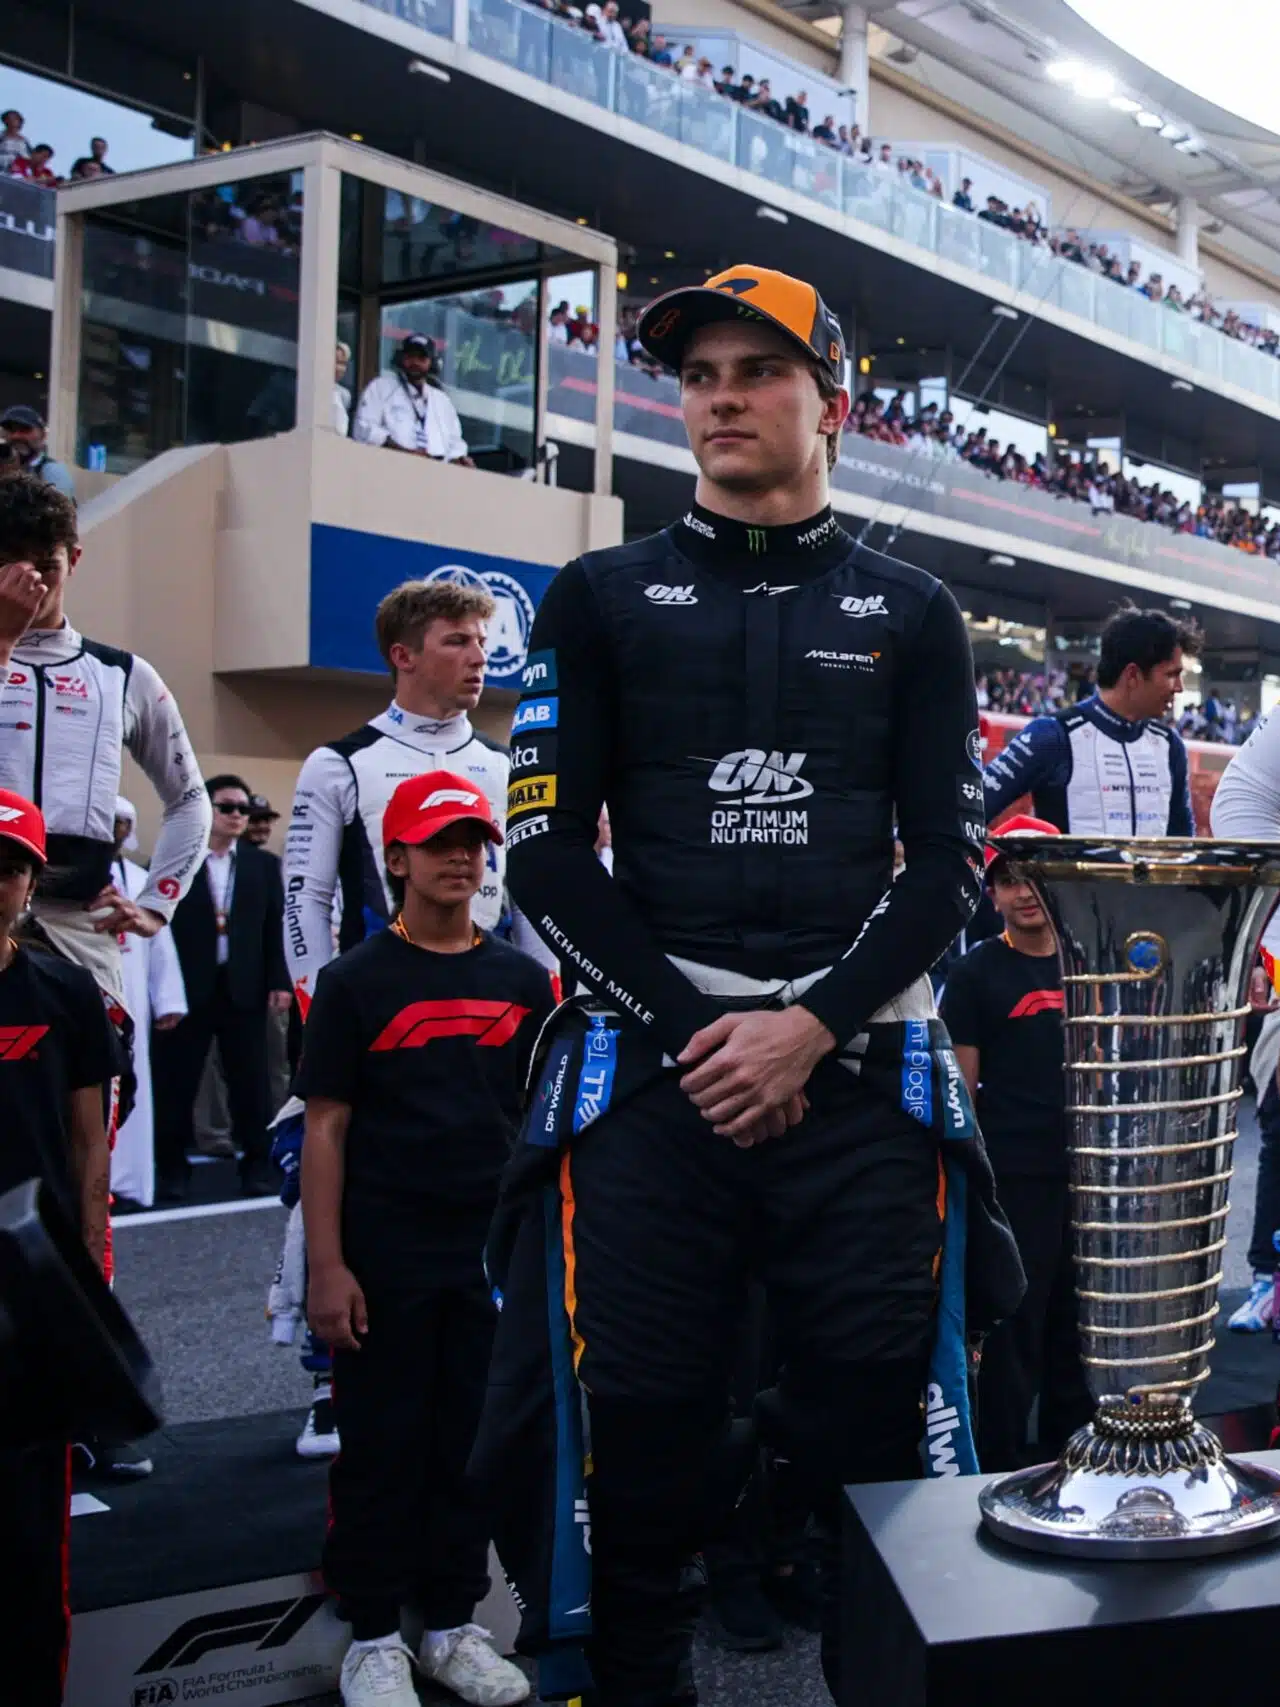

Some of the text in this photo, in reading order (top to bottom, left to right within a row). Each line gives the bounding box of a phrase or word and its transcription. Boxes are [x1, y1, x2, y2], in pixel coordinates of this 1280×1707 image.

[804, 650, 874, 664] McLaren
[711, 810, 808, 828] OPTIMUM
[711, 828, 808, 844] NUTRITION
[541, 915, 655, 1025] RICHARD MILLE
[545, 1055, 569, 1133] DP WORLD
[182, 1663, 322, 1701] World Championship
[183, 1676, 206, 1690] FIA
[208, 1663, 267, 1684] Formula
